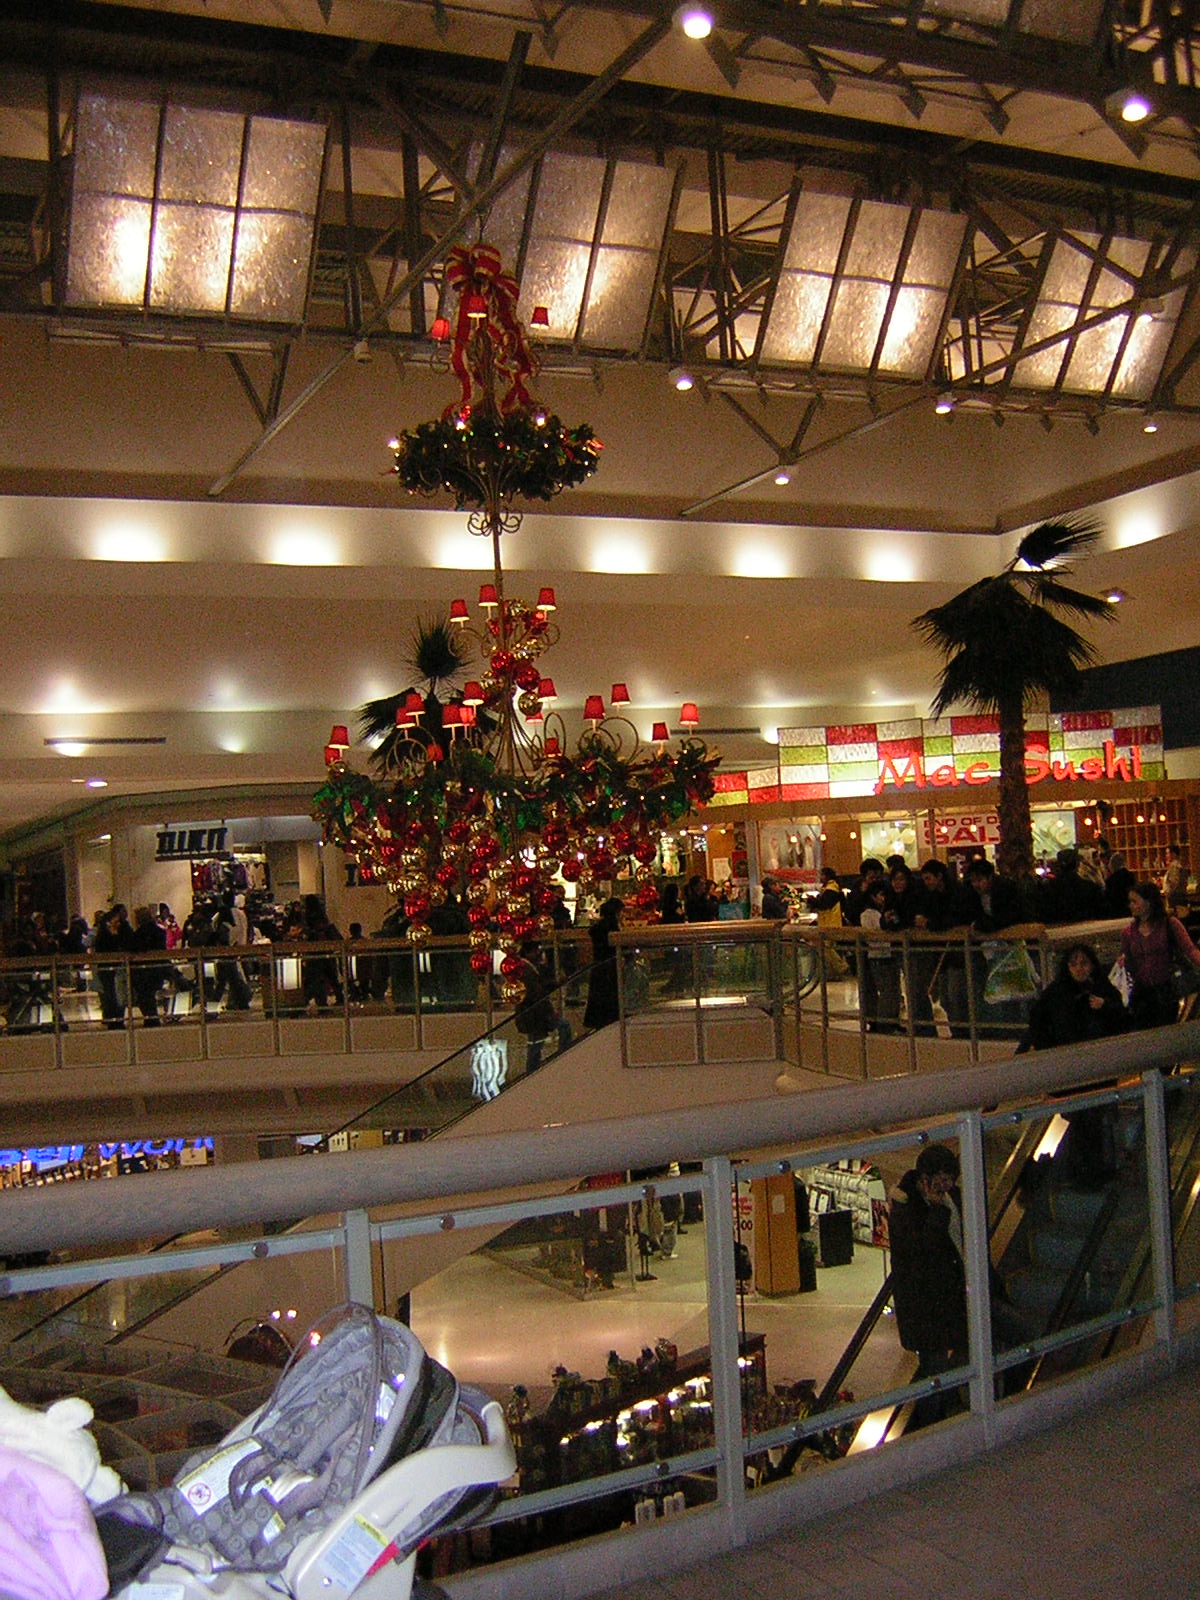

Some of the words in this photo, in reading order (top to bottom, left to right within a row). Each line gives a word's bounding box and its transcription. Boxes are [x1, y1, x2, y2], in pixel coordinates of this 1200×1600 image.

[873, 752, 992, 796] Mac
[1024, 739, 1142, 785] Sushi
[961, 816, 982, 827] OF
[924, 825, 1000, 846] SAL
